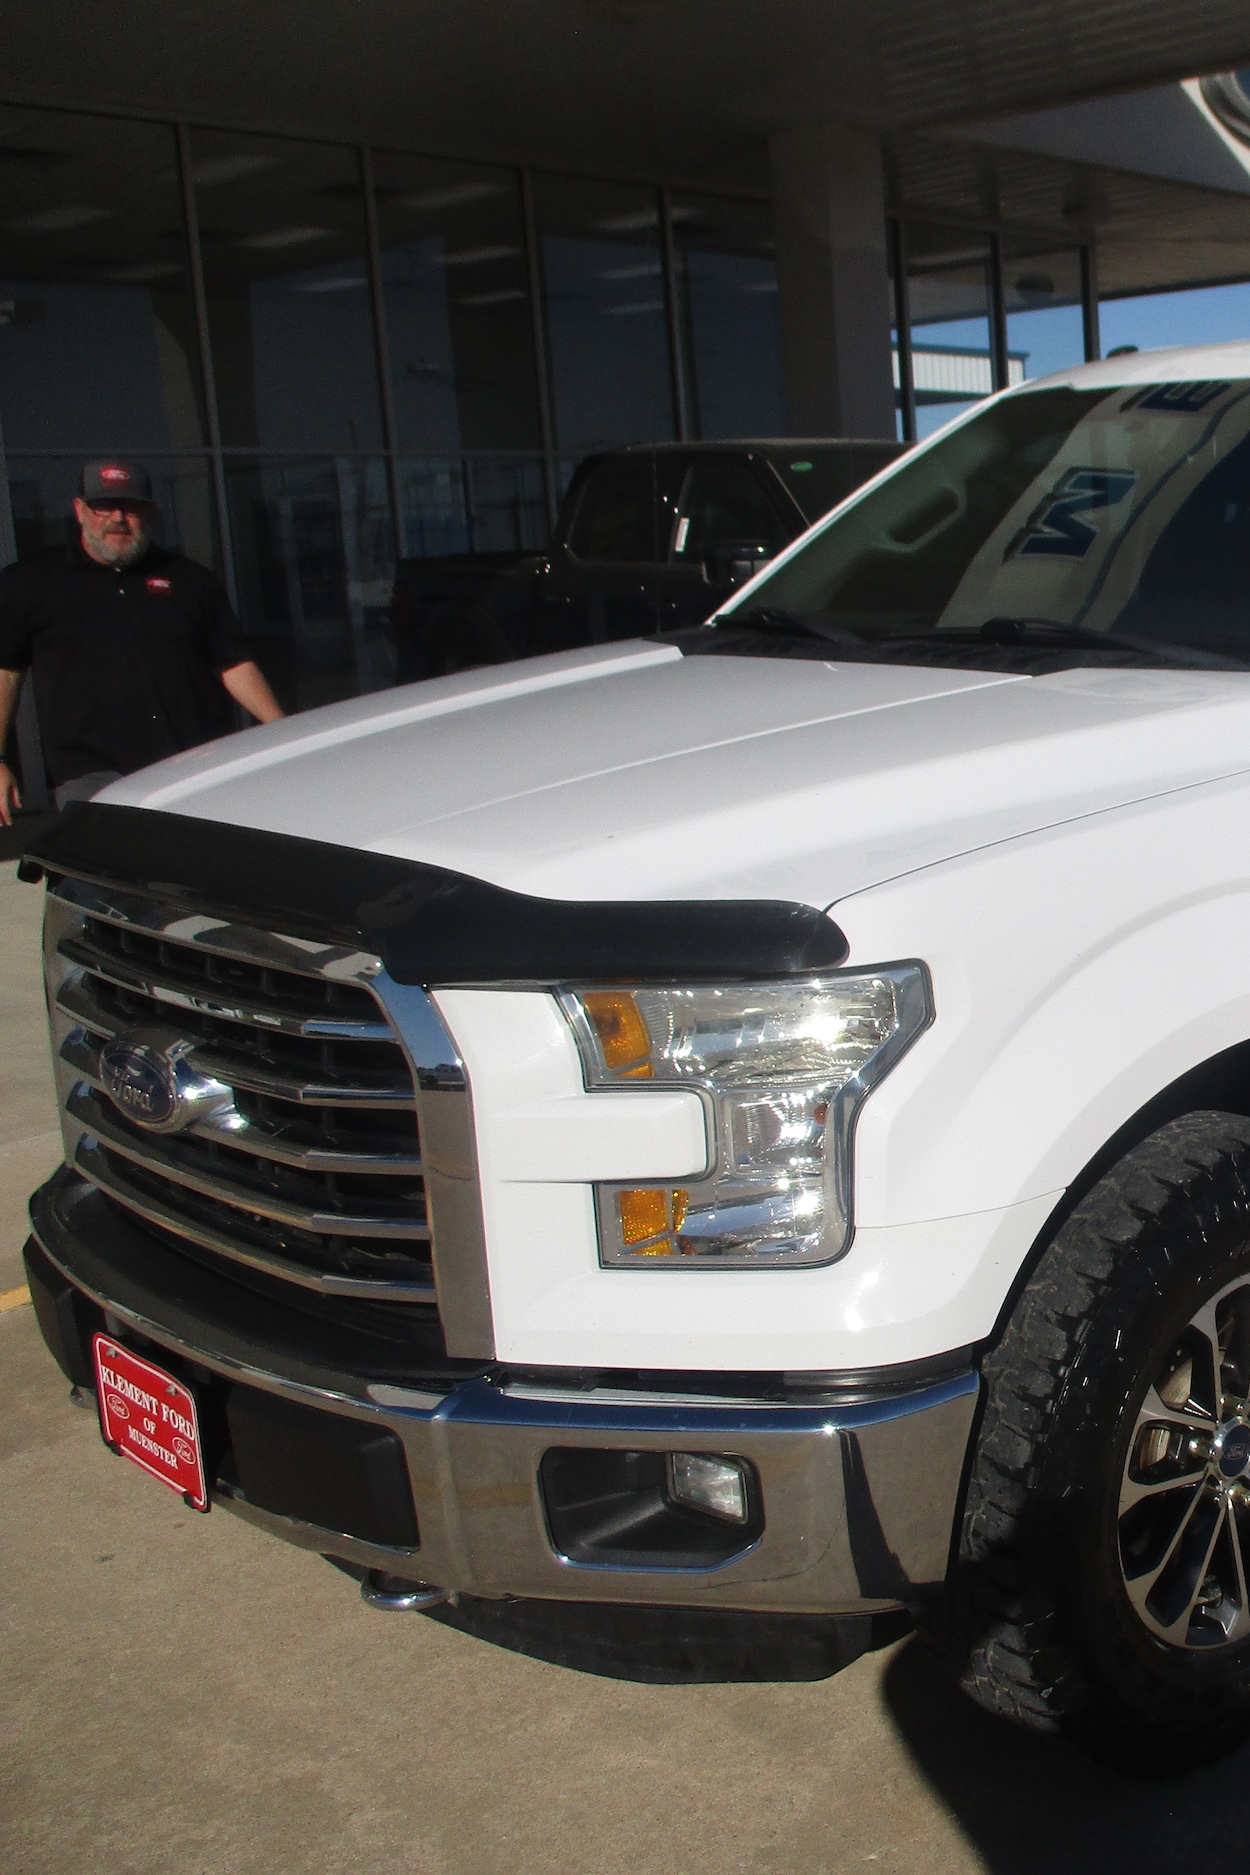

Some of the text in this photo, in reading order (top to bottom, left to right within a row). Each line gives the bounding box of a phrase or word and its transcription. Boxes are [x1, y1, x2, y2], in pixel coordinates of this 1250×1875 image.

[101, 1364, 195, 1442] KLEMENT FORD
[128, 1425, 179, 1470] MUENSTER
[143, 1417, 157, 1436] OF
